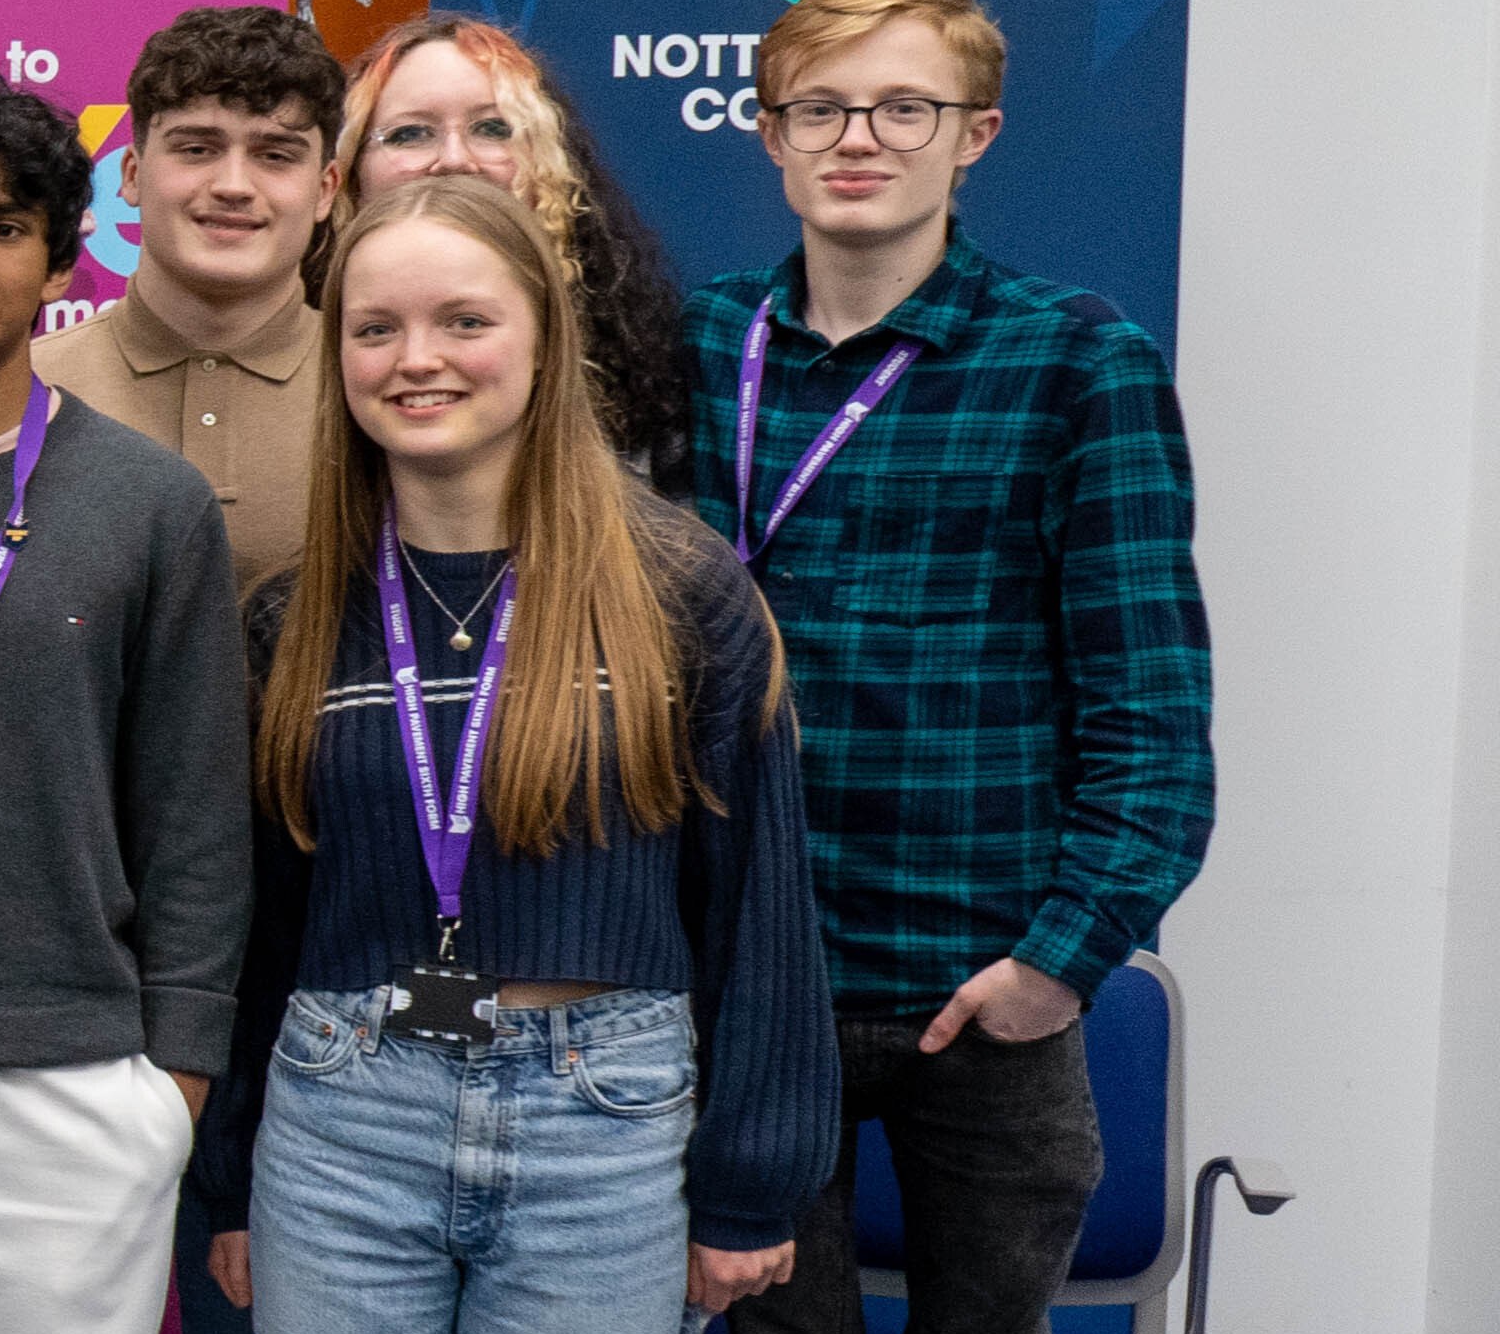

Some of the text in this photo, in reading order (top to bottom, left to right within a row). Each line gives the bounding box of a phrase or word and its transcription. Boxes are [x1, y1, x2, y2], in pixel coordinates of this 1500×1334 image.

[7, 40, 60, 85] to
[613, 33, 762, 78] NOTT
[682, 88, 759, 133] CO
[496, 599, 516, 643] STUDENT
[403, 684, 442, 832] HIGH PAVEMENT SIXTH FORM
[455, 666, 498, 815] HIGH PAVEMENT SIXTH FORM
